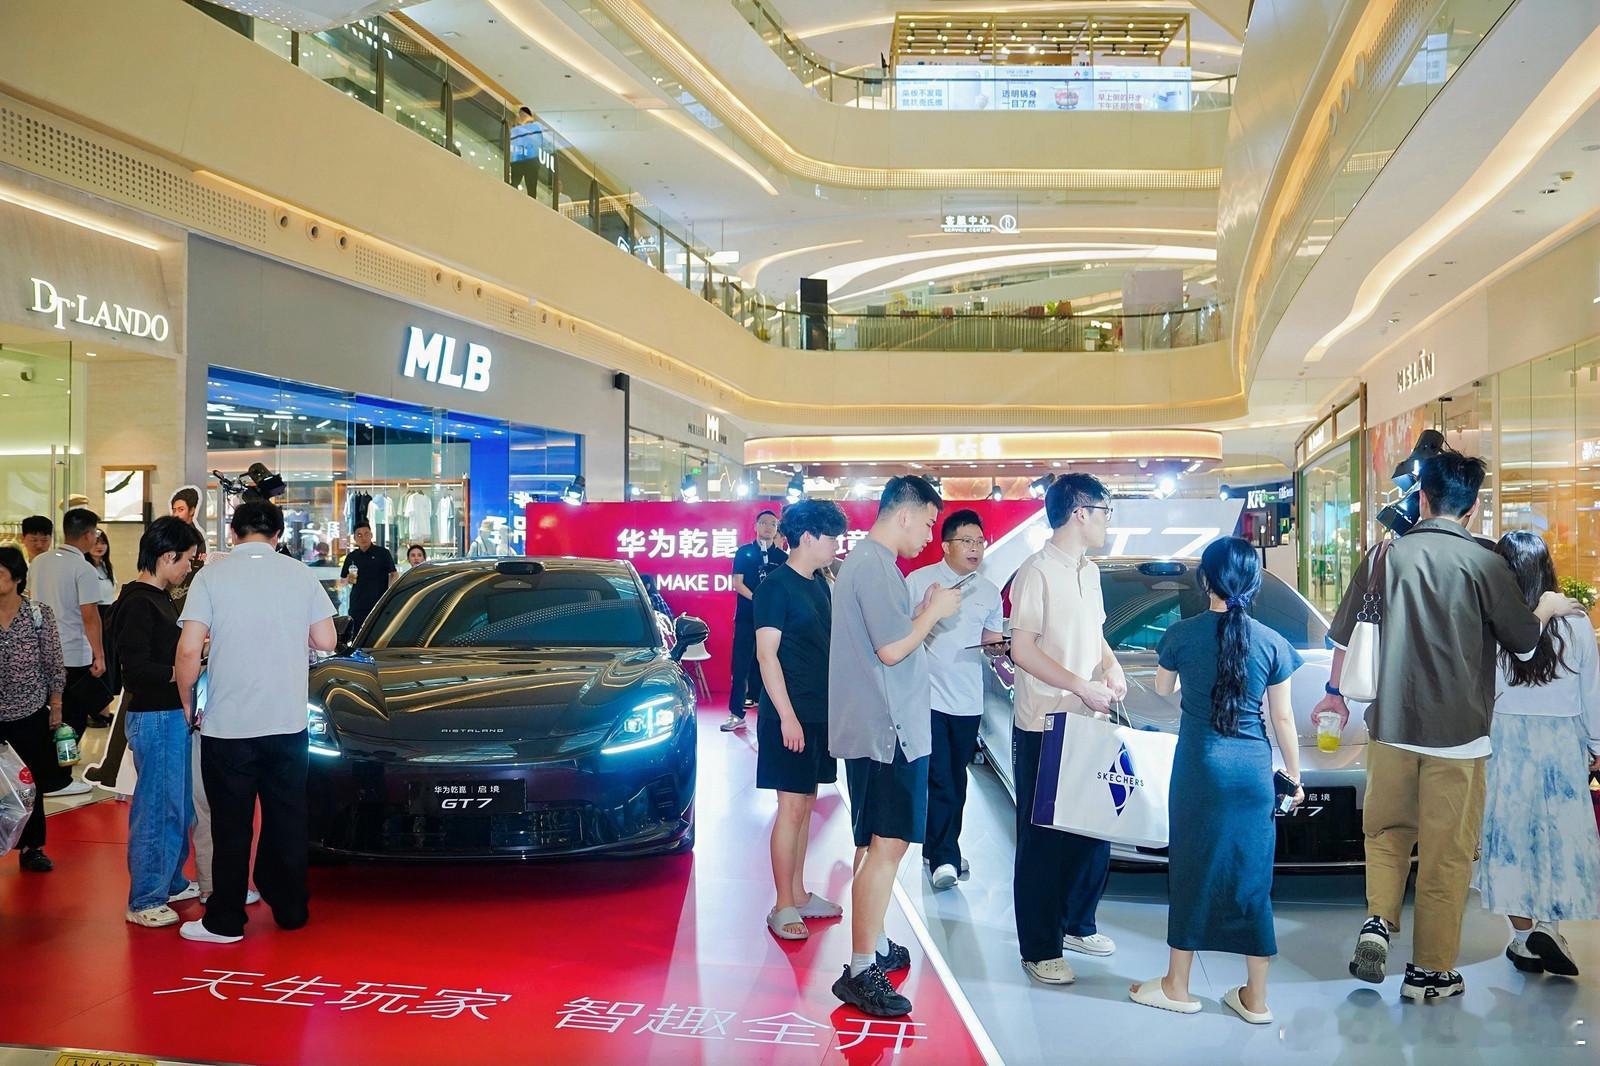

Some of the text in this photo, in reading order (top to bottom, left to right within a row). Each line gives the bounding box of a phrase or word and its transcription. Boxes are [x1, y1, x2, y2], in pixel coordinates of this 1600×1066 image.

[1002, 89, 1037, 98] 透明锅身
[1002, 99, 1037, 108] 一目了然
[403, 326, 491, 392] MLB
[1247, 489, 1266, 509] KFC
[616, 528, 738, 559] 华为乾崑
[1106, 527, 1220, 557] T7
[656, 574, 737, 591] MAKE DI
[1097, 771, 1144, 787] SKECHERS
[434, 785, 500, 794] 华为乾崑 启境
[1308, 792, 1331, 801] 启境
[152, 969, 928, 1054] 天生玩家 智趣全开
